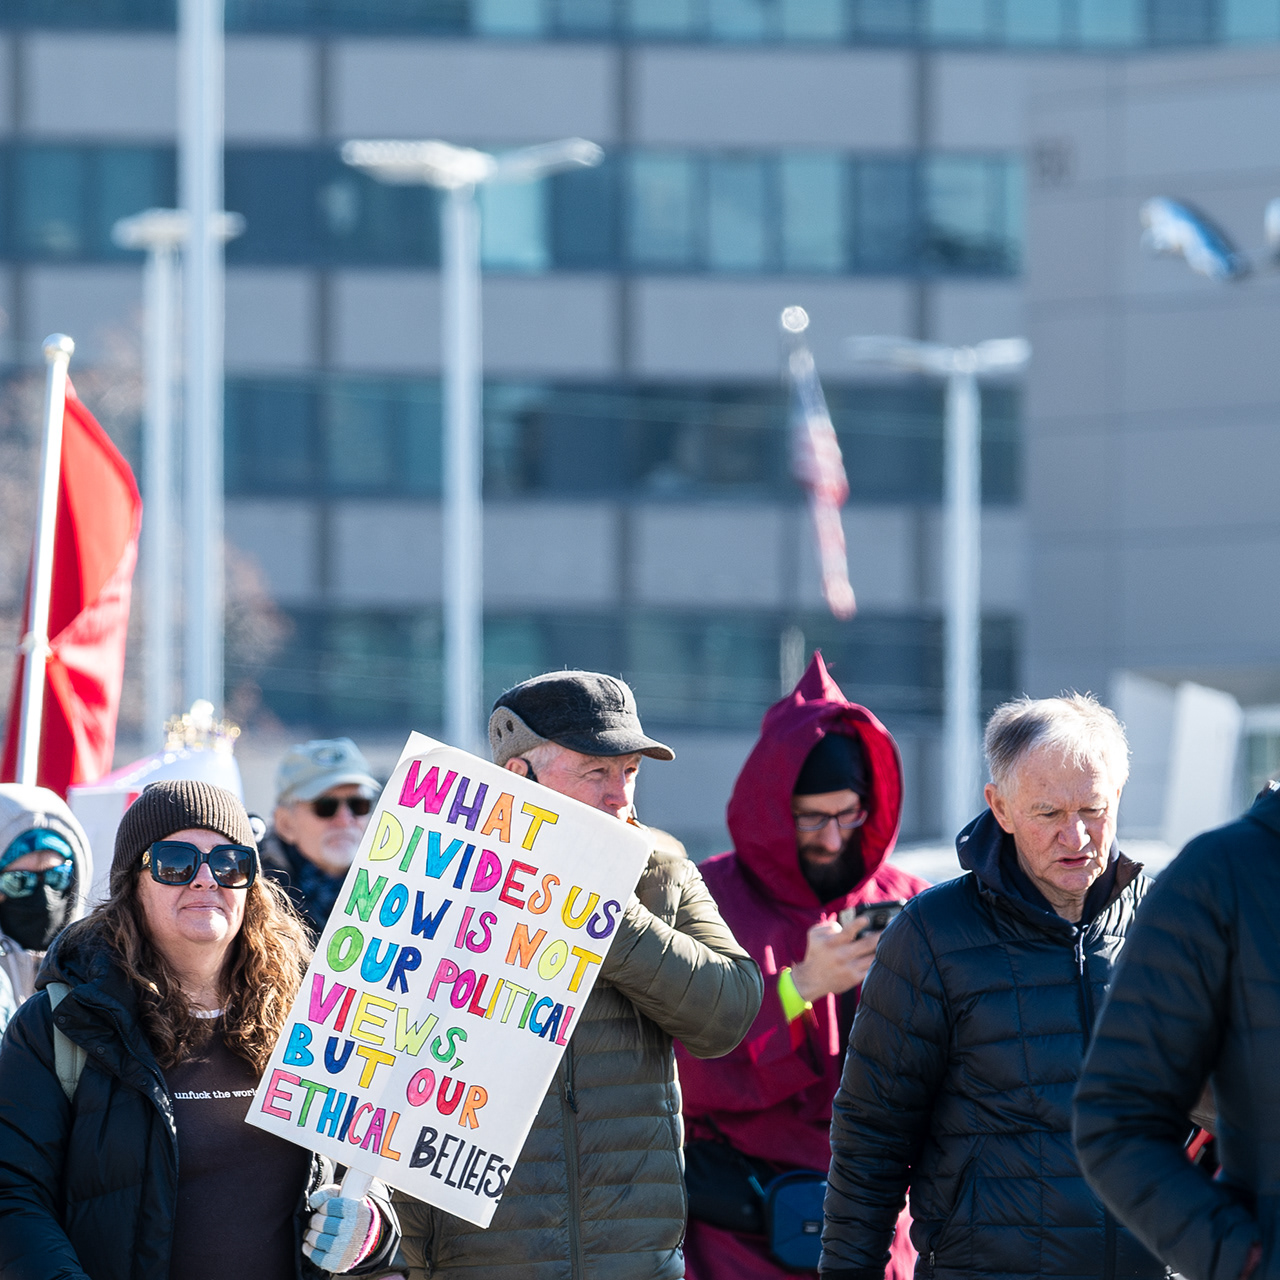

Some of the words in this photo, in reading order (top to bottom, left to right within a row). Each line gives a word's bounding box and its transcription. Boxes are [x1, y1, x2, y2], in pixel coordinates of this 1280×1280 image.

[399, 760, 559, 851] WHAT
[368, 810, 561, 915] DIVIDES
[561, 885, 621, 940] US
[344, 868, 453, 941] NOW
[454, 906, 498, 954] IS
[505, 923, 603, 993] NOT
[307, 973, 468, 1071] VIEWS,
[327, 925, 421, 993] OUR
[427, 958, 576, 1047] POLITICAL
[174, 1090, 212, 1099] unfuck
[212, 1090, 231, 1099] the
[261, 1068, 402, 1162] ETHICAL
[283, 1022, 397, 1089] BUT
[406, 1067, 489, 1129] OUR
